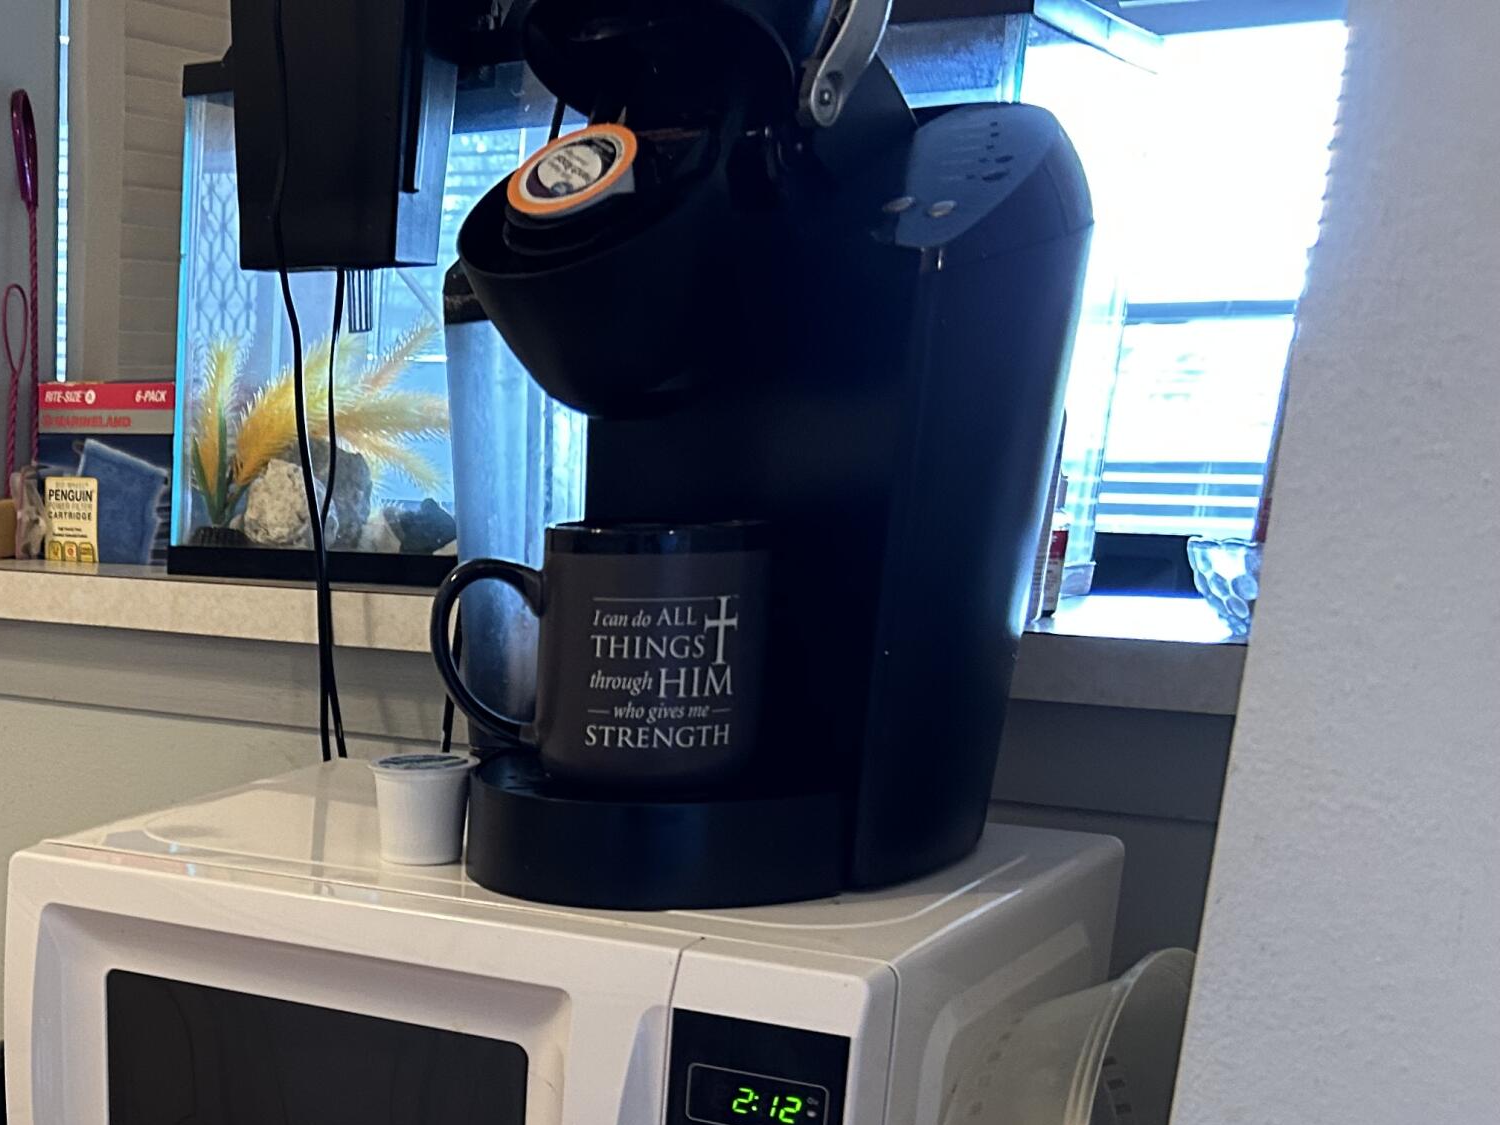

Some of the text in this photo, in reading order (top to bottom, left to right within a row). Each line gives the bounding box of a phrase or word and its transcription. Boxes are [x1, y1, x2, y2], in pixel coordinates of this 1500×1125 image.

[135, 390, 167, 403] 6-PACK
[48, 489, 92, 502] PENGUIN
[48, 511, 92, 521] CARTRIDGE
[593, 606, 697, 627] I can do ALL
[590, 634, 706, 660] THINGS
[589, 665, 733, 698] through HIM
[613, 701, 710, 724] who gives me
[585, 723, 730, 748] STRENGTH
[731, 1086, 803, 1125] 2:12
